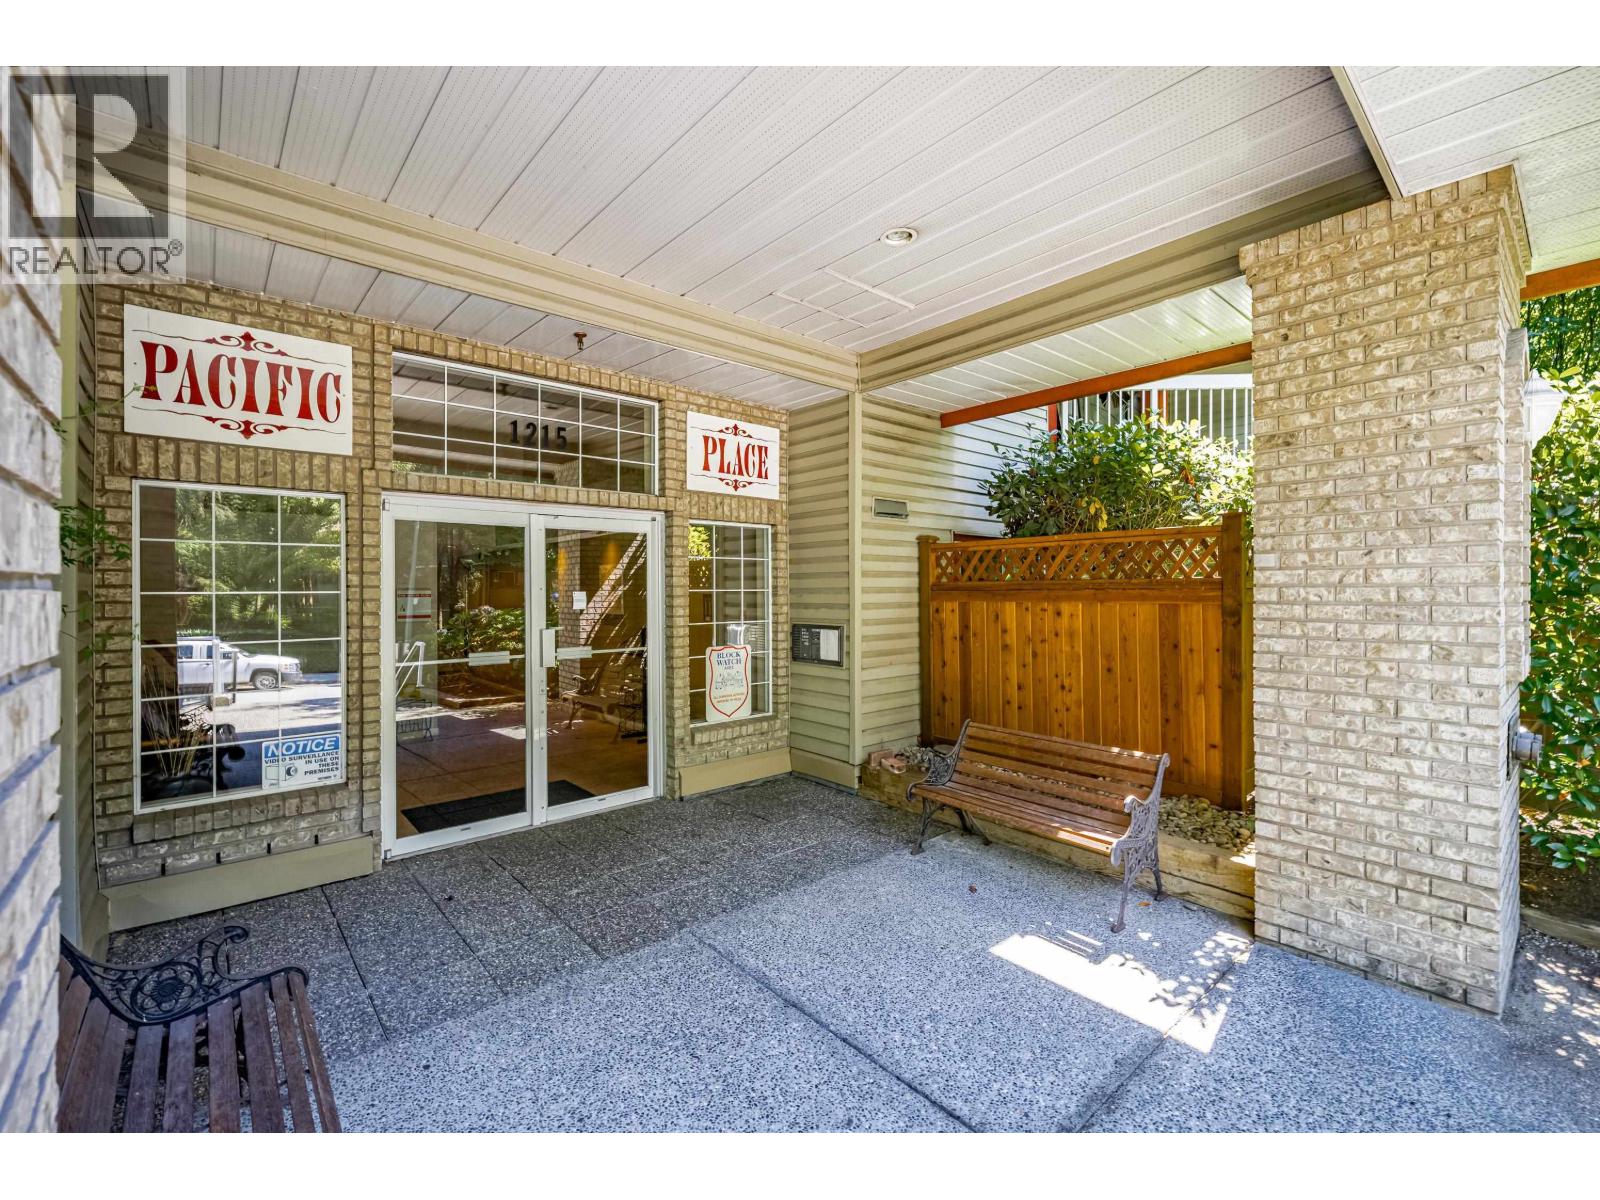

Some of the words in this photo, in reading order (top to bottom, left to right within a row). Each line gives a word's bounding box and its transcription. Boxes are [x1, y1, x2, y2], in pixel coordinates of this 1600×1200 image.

[140, 340, 342, 424] PACIFIC
[508, 419, 569, 451] 1215
[701, 434, 769, 480] PLACE
[717, 651, 741, 659] BLOCK
[267, 737, 337, 757] NOTICE
[288, 751, 340, 761] SURVEILLANCE
[304, 767, 340, 776] PREMISES
